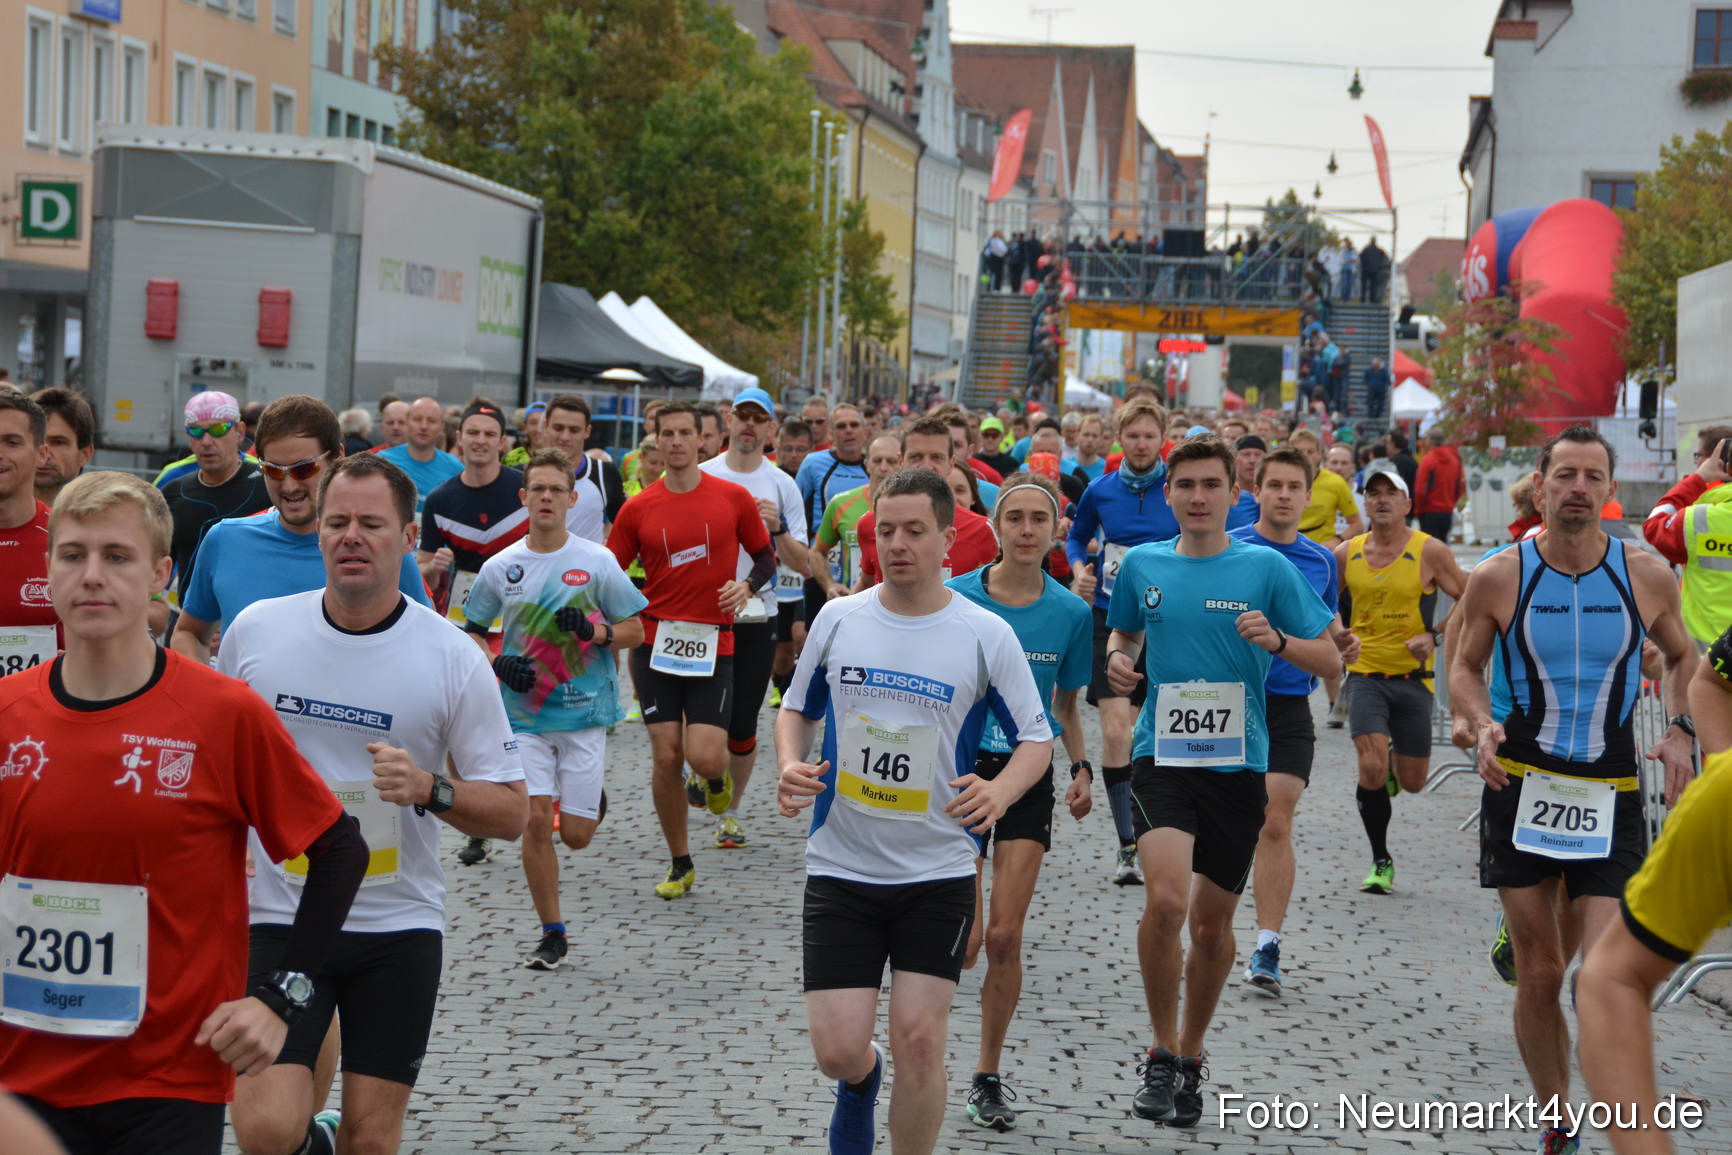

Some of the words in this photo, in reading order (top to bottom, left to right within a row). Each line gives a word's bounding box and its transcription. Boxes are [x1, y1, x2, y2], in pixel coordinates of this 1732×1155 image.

[30, 189, 71, 232] D
[1158, 310, 1207, 330] ZIEL
[680, 551, 697, 561] DEHN
[1205, 599, 1250, 612] BOCK
[662, 637, 707, 658] 2269
[671, 661, 694, 669] Jürgen
[873, 671, 949, 699] BÜSCHEL
[840, 685, 950, 714] FEINSCHNEIDTEAM
[309, 703, 387, 728] BÜSCHEL
[1169, 709, 1231, 734] 2647
[344, 726, 390, 739] WERKZEUGBAU
[875, 729, 909, 741] BOCK
[122, 734, 144, 744] TSV
[147, 737, 197, 750] Wolfstein
[1186, 743, 1215, 752] Tobias
[861, 746, 910, 783] 146
[155, 789, 188, 799] Laufsport
[861, 785, 898, 803] Markus
[1558, 785, 1588, 796] BOCK
[1531, 800, 1598, 832] 2705
[1540, 835, 1584, 848] Reinhard
[47, 895, 100, 911] BOCK
[16, 925, 114, 975] 2301
[43, 988, 85, 1010] Seger
